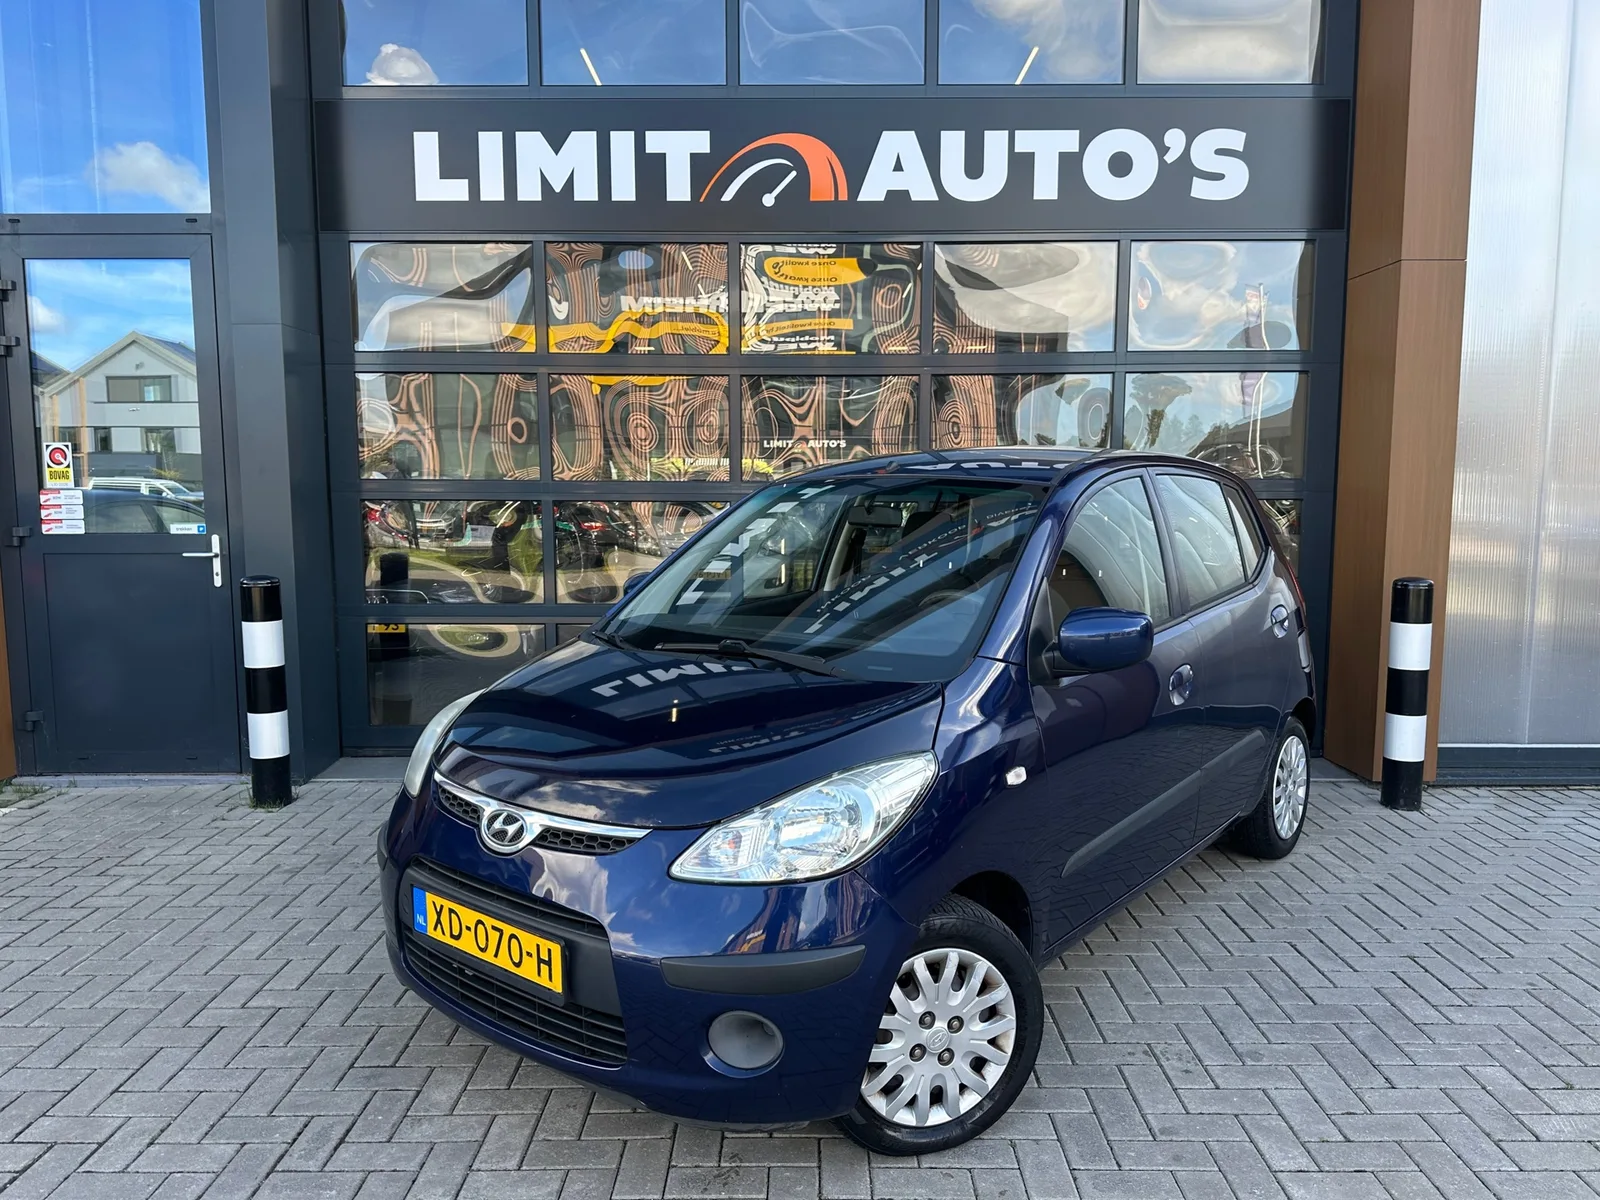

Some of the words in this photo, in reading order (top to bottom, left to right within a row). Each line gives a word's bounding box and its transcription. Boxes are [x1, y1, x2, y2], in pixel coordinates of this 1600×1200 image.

[413, 130, 711, 203] LIMIT
[856, 127, 1250, 202] AUTO'S
[763, 439, 794, 448] LIMIT
[807, 439, 846, 448] AUTO'S
[49, 470, 70, 480] BOVAG
[416, 914, 427, 926] NL
[432, 900, 553, 983] XD-070-H
